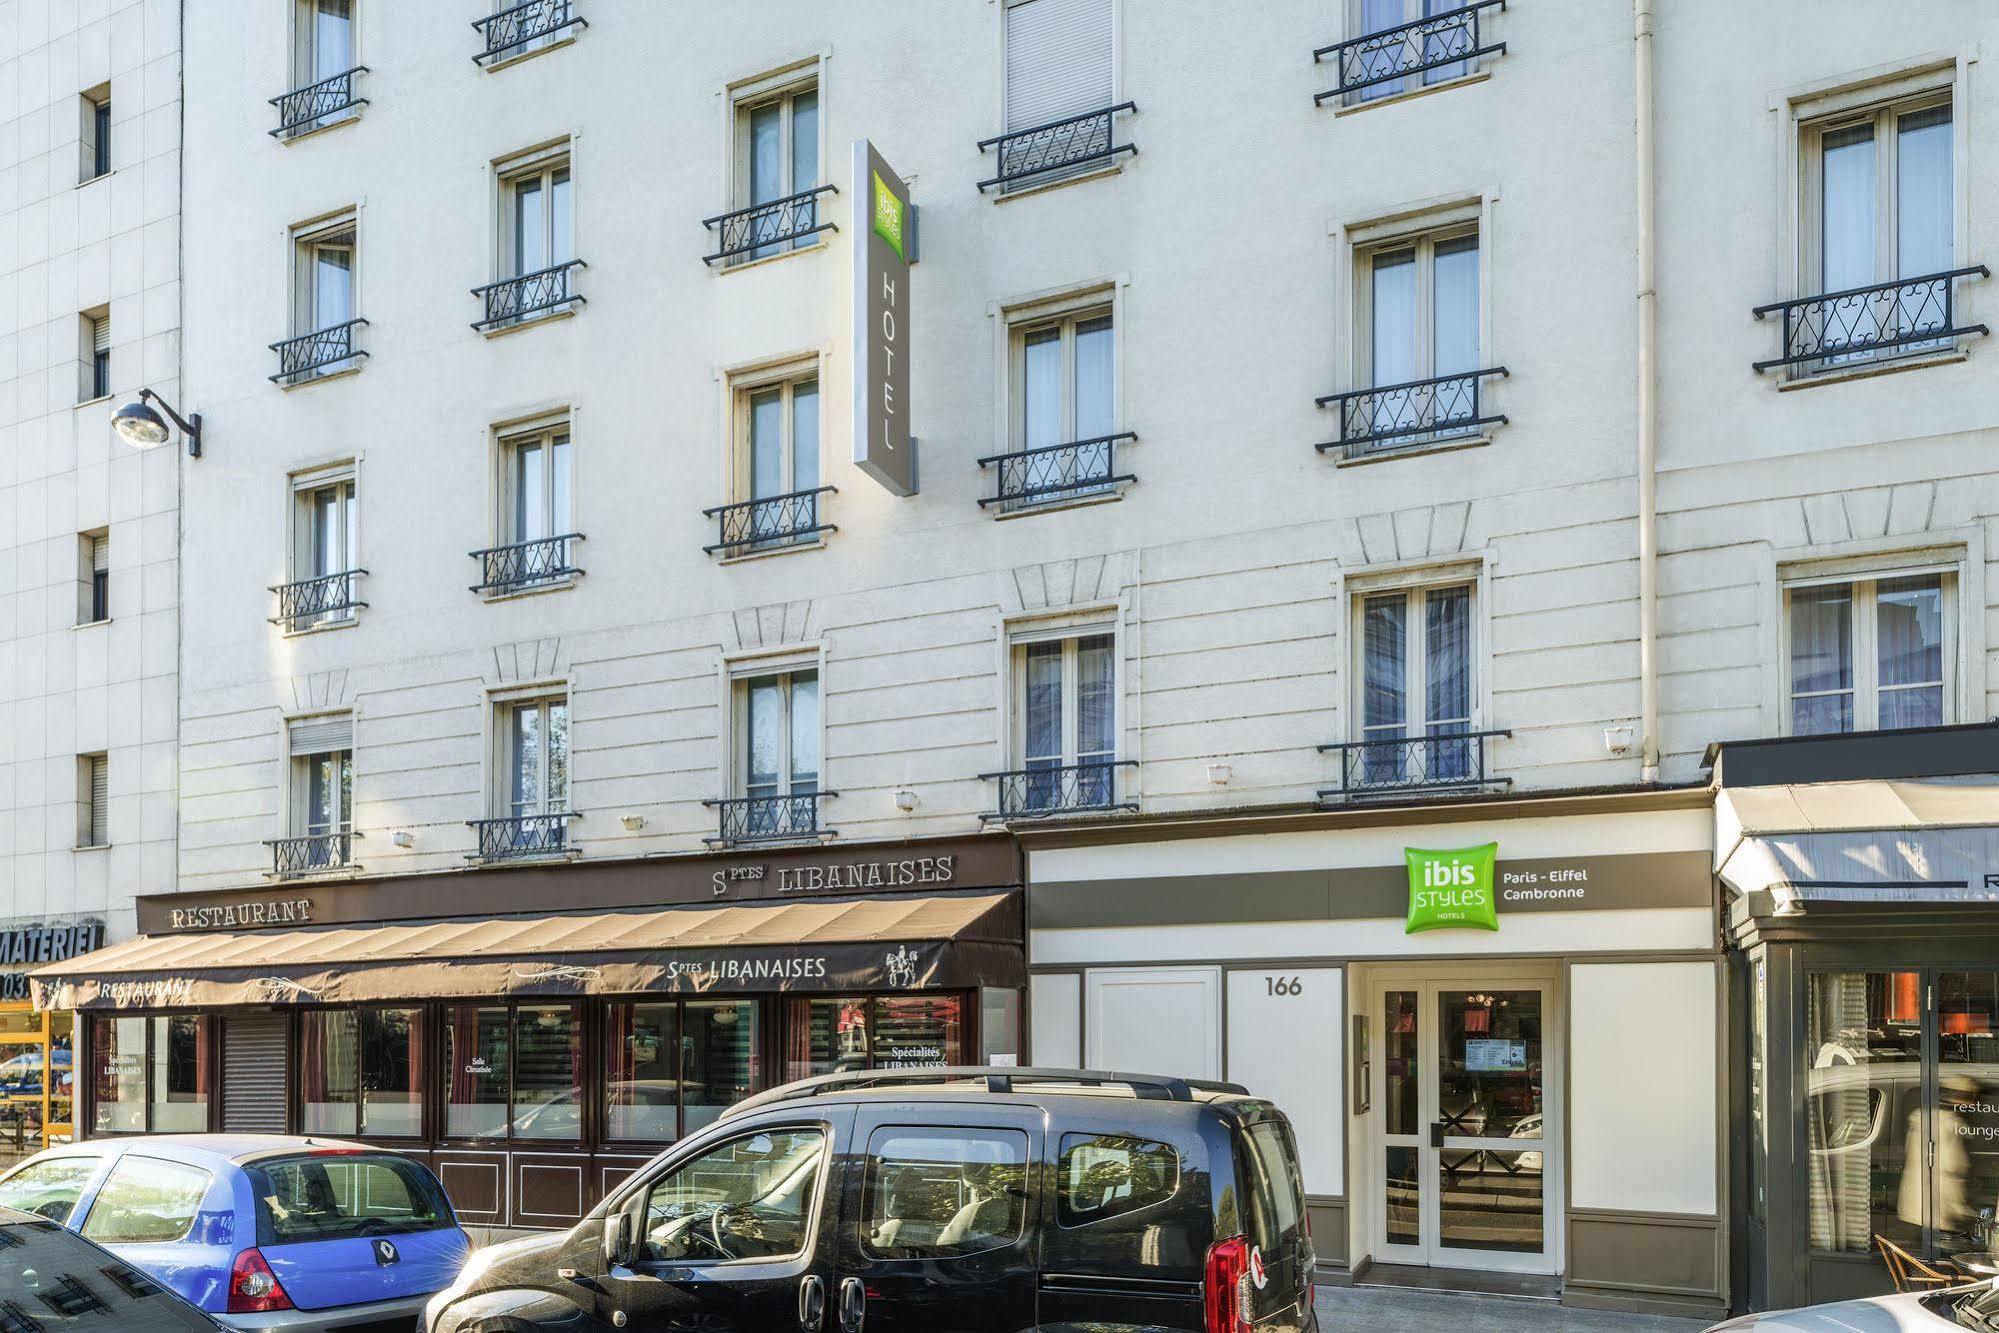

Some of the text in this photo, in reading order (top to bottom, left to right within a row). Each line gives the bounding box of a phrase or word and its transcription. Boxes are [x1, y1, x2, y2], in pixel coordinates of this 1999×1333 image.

[881, 192, 897, 223] ibis
[883, 271, 895, 450] HOTEL
[777, 856, 953, 892] LIBANAISES
[1424, 859, 1476, 887] ibis
[1503, 871, 1538, 884] Paris
[1549, 869, 1588, 882] Eiffel
[1503, 887, 1585, 901] Cambronne
[172, 900, 310, 928] RESTAURANT
[710, 957, 826, 978] LIBANAISES
[100, 977, 195, 999] RESTAURANT
[1265, 976, 1302, 996] 166
[891, 1046, 940, 1059] Spécialités
[1953, 1100, 1999, 1113] restau
